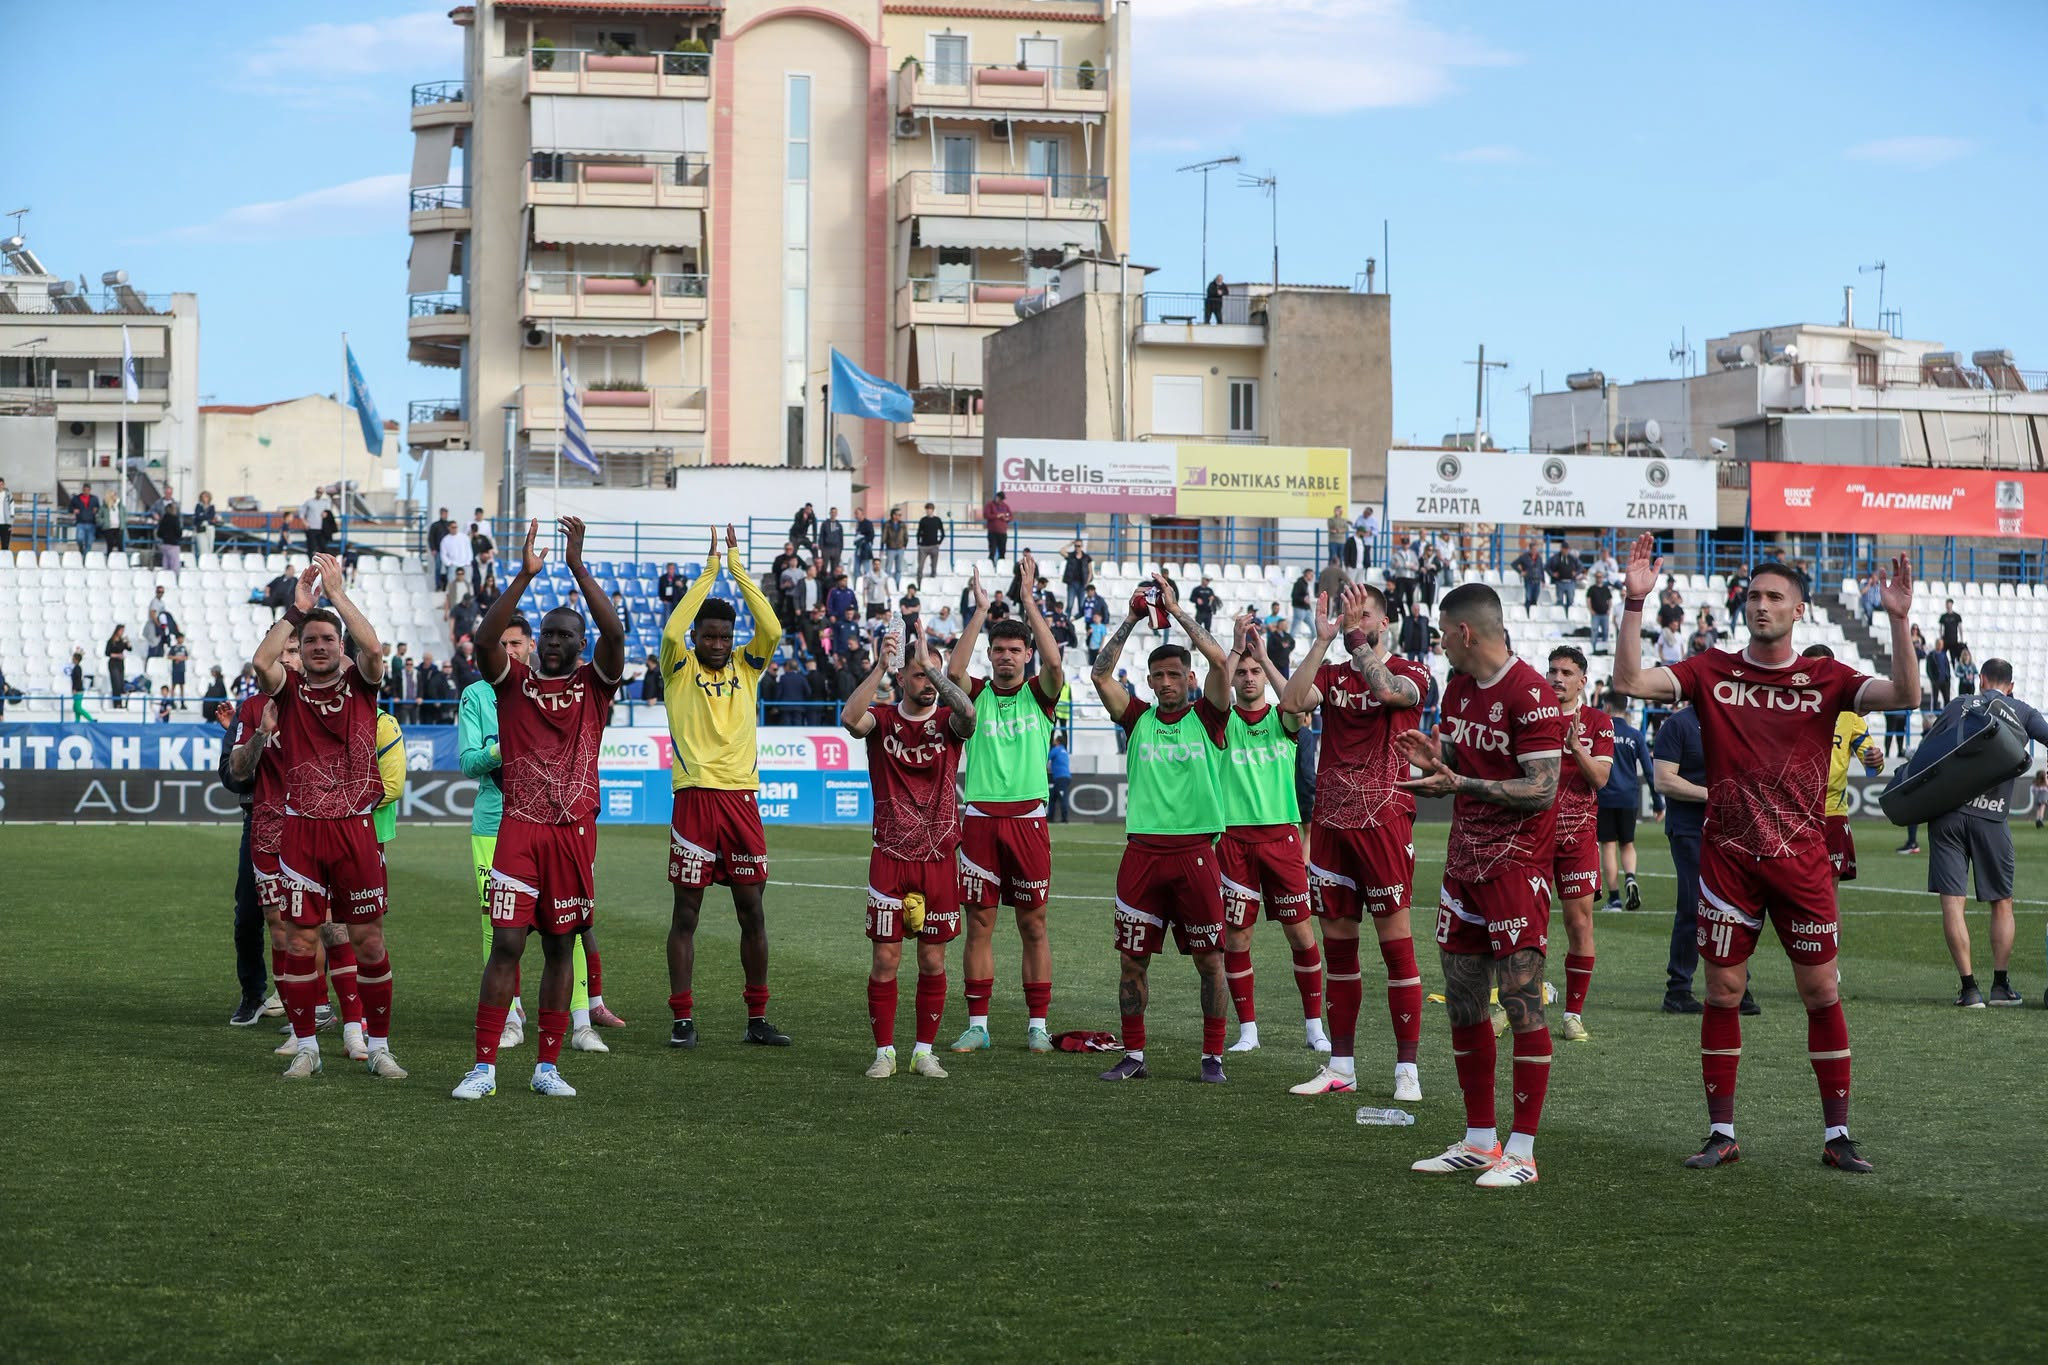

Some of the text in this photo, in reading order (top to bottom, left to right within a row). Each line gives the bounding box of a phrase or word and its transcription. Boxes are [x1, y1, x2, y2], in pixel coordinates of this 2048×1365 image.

[1003, 457, 1104, 483] GNtelis
[1211, 473, 1340, 491] PONTIKAS MARBLE
[1416, 497, 1480, 515] ZAPATA
[1523, 500, 1585, 518] ZAPATA
[1785, 498, 1811, 507] COLA
[1861, 492, 1953, 511] ΠΑΓΩΜΕΝΗ
[1626, 503, 1688, 520] ZAPATA
[1516, 706, 1560, 725] volton
[681, 858, 702, 884] 26
[962, 876, 983, 903] 74
[291, 891, 303, 917] 8
[352, 904, 377, 915] .com
[492, 890, 516, 920] 69
[1225, 898, 1246, 925] 29
[556, 911, 577, 924] .com
[876, 910, 893, 936] 10
[1122, 923, 1146, 951] 32
[1711, 923, 1733, 958] 41
[1792, 940, 1822, 952] .com
